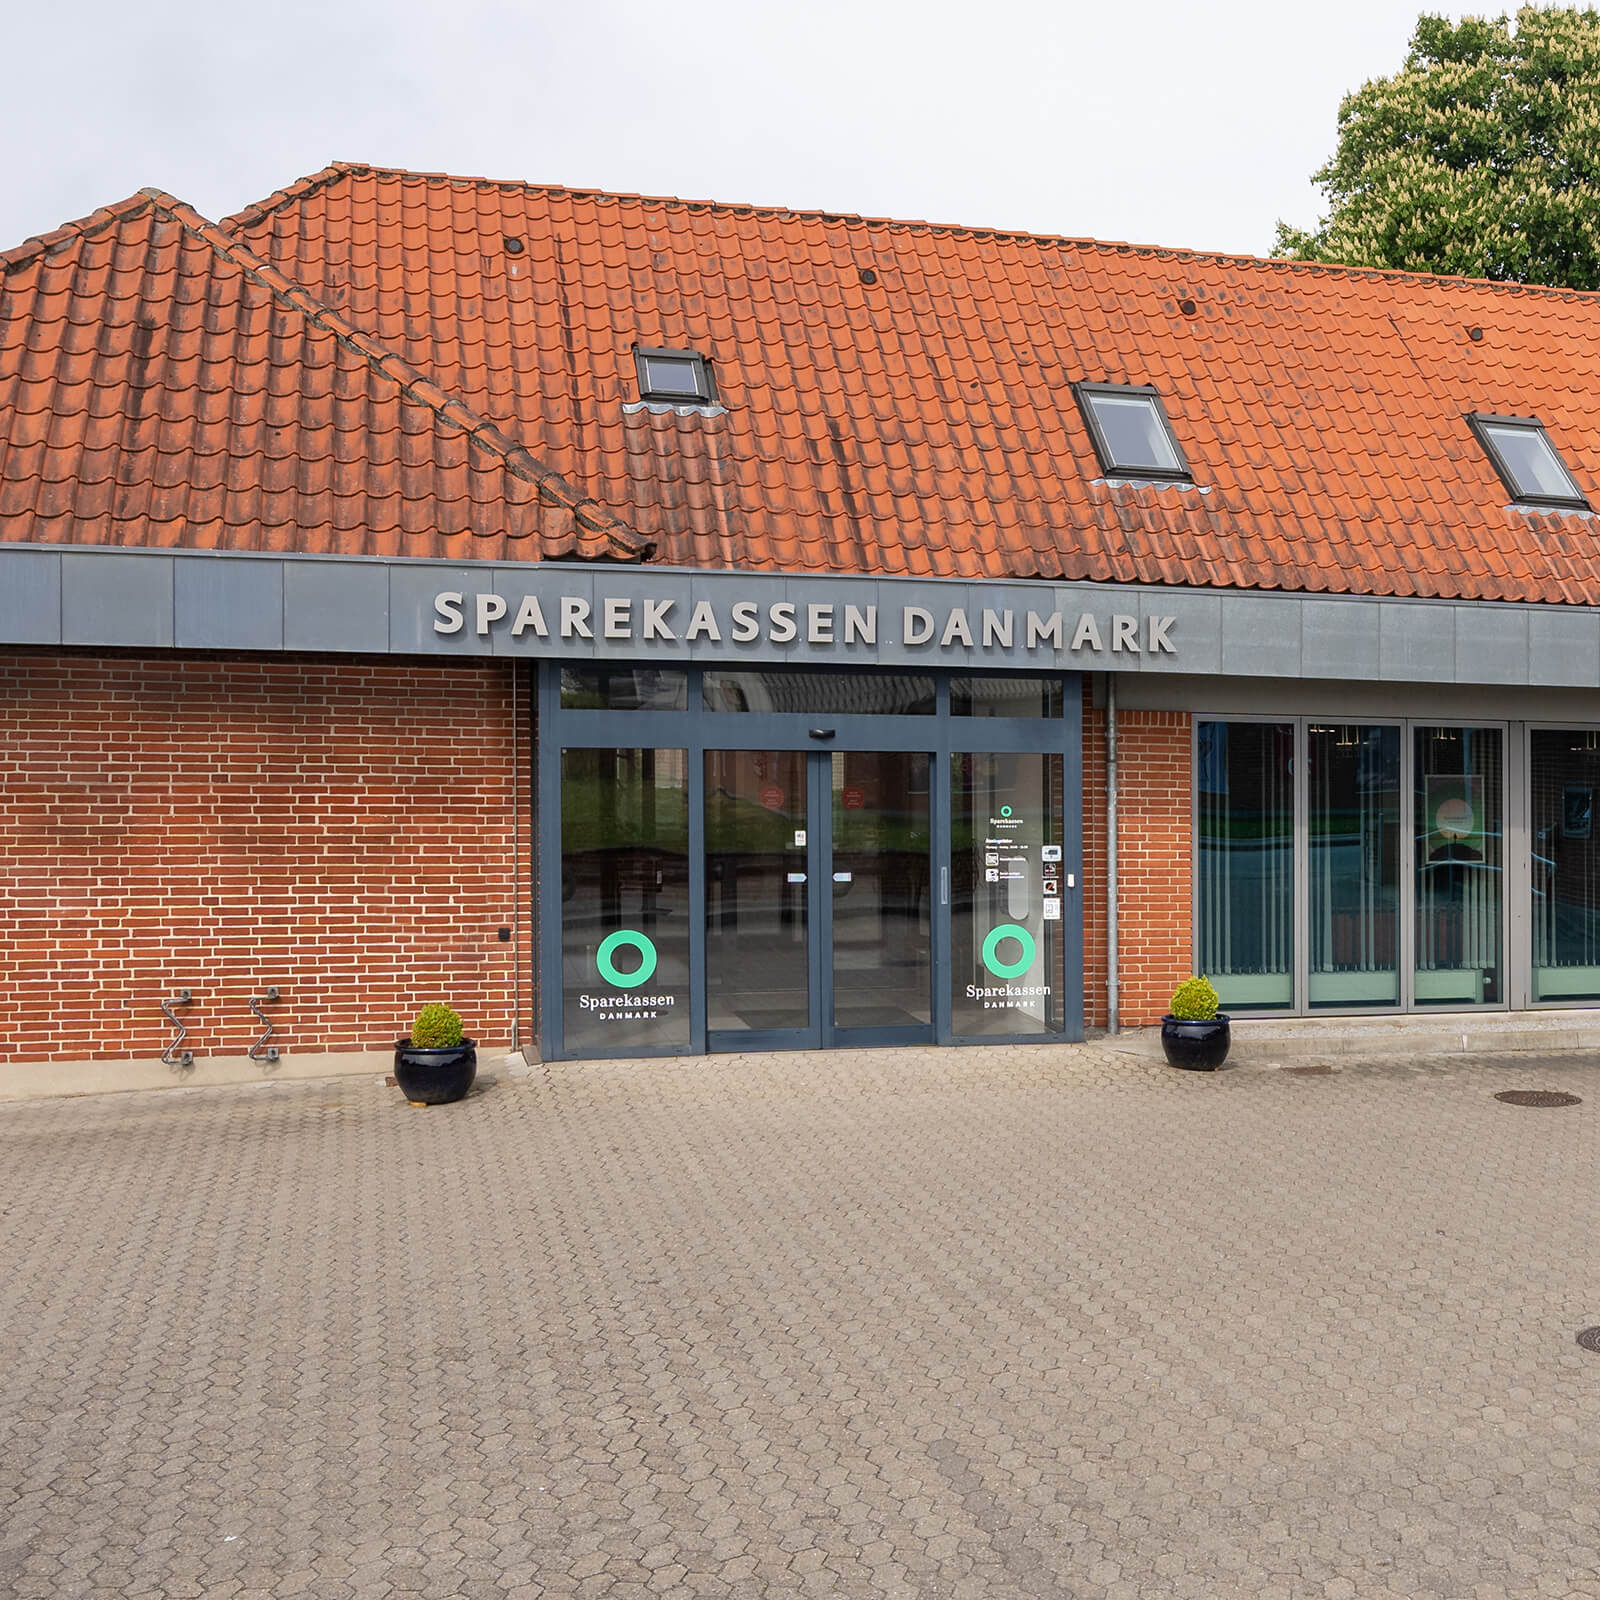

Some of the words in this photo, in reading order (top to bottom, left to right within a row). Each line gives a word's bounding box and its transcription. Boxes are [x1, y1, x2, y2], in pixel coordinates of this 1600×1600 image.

[433, 591, 877, 645] SPAREKASSEN
[903, 597, 1177, 653] DANMARK
[966, 984, 1051, 1000] Sparekassen
[579, 994, 675, 1011] Sparekassen
[984, 1001, 1036, 1009] DANMARK
[599, 1011, 657, 1020] DANMARK
